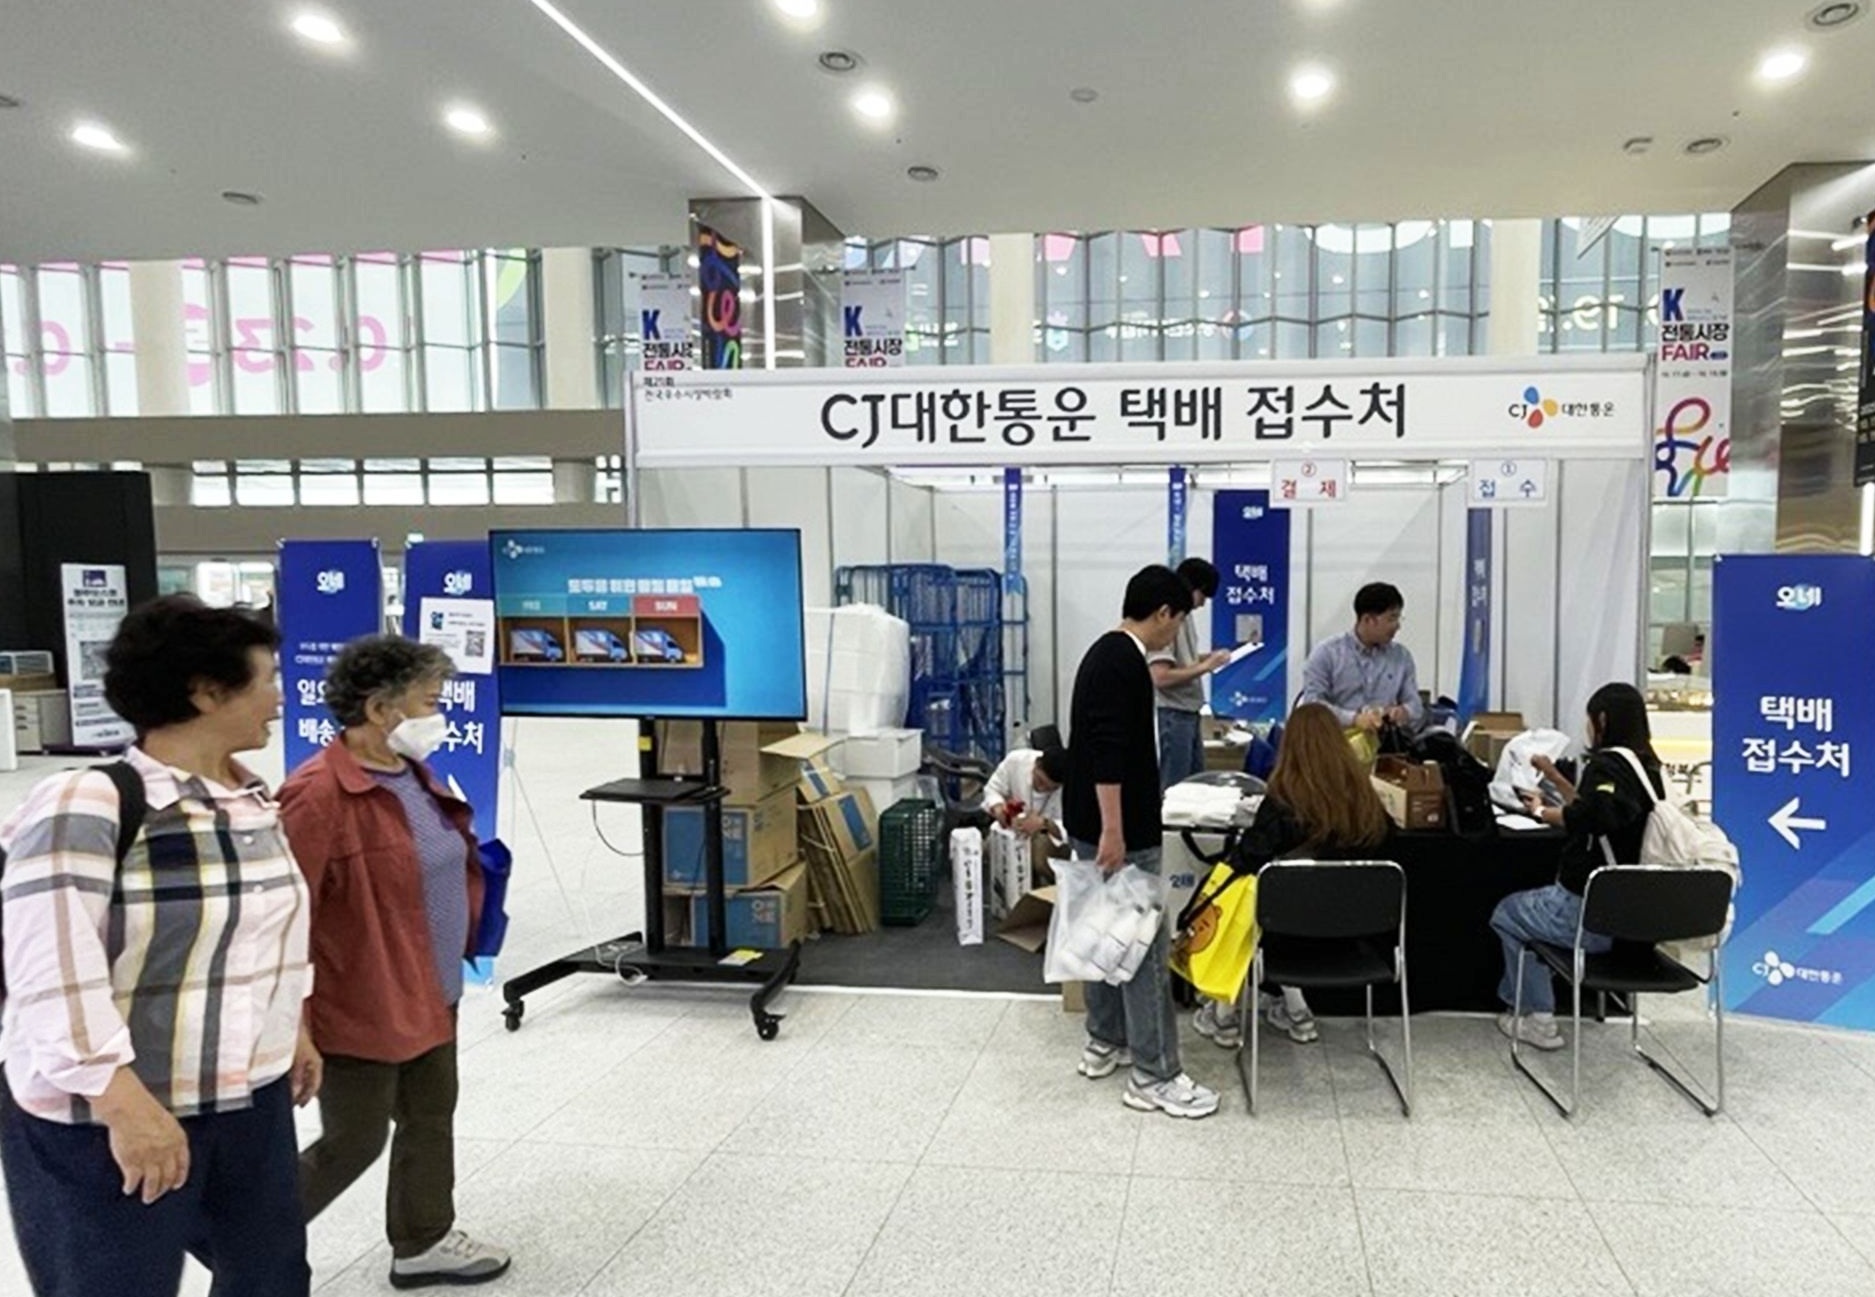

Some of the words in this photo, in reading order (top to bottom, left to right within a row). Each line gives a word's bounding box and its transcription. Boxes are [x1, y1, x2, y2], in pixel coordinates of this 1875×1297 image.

[1662, 288, 1684, 321] K
[642, 310, 661, 340] K
[844, 305, 863, 337] K
[1662, 323, 1729, 341] 전통시장
[844, 339, 902, 356] 전통시장
[1662, 343, 1709, 360] FAIR
[820, 387, 1097, 449] CJ대한통운
[1120, 386, 1222, 441] 택배
[1246, 382, 1405, 440] 접수처
[1508, 403, 1528, 420] CJ
[1561, 401, 1615, 417] 대한통운
[1519, 479, 1537, 498] 수
[588, 600, 608, 611] SAT
[654, 600, 679, 612] SUN
[1225, 585, 1275, 605] 접수처
[1776, 585, 1822, 609] 오네
[1760, 696, 1833, 732] 택배
[440, 721, 484, 754] 수처
[1741, 738, 1850, 777] 접수처
